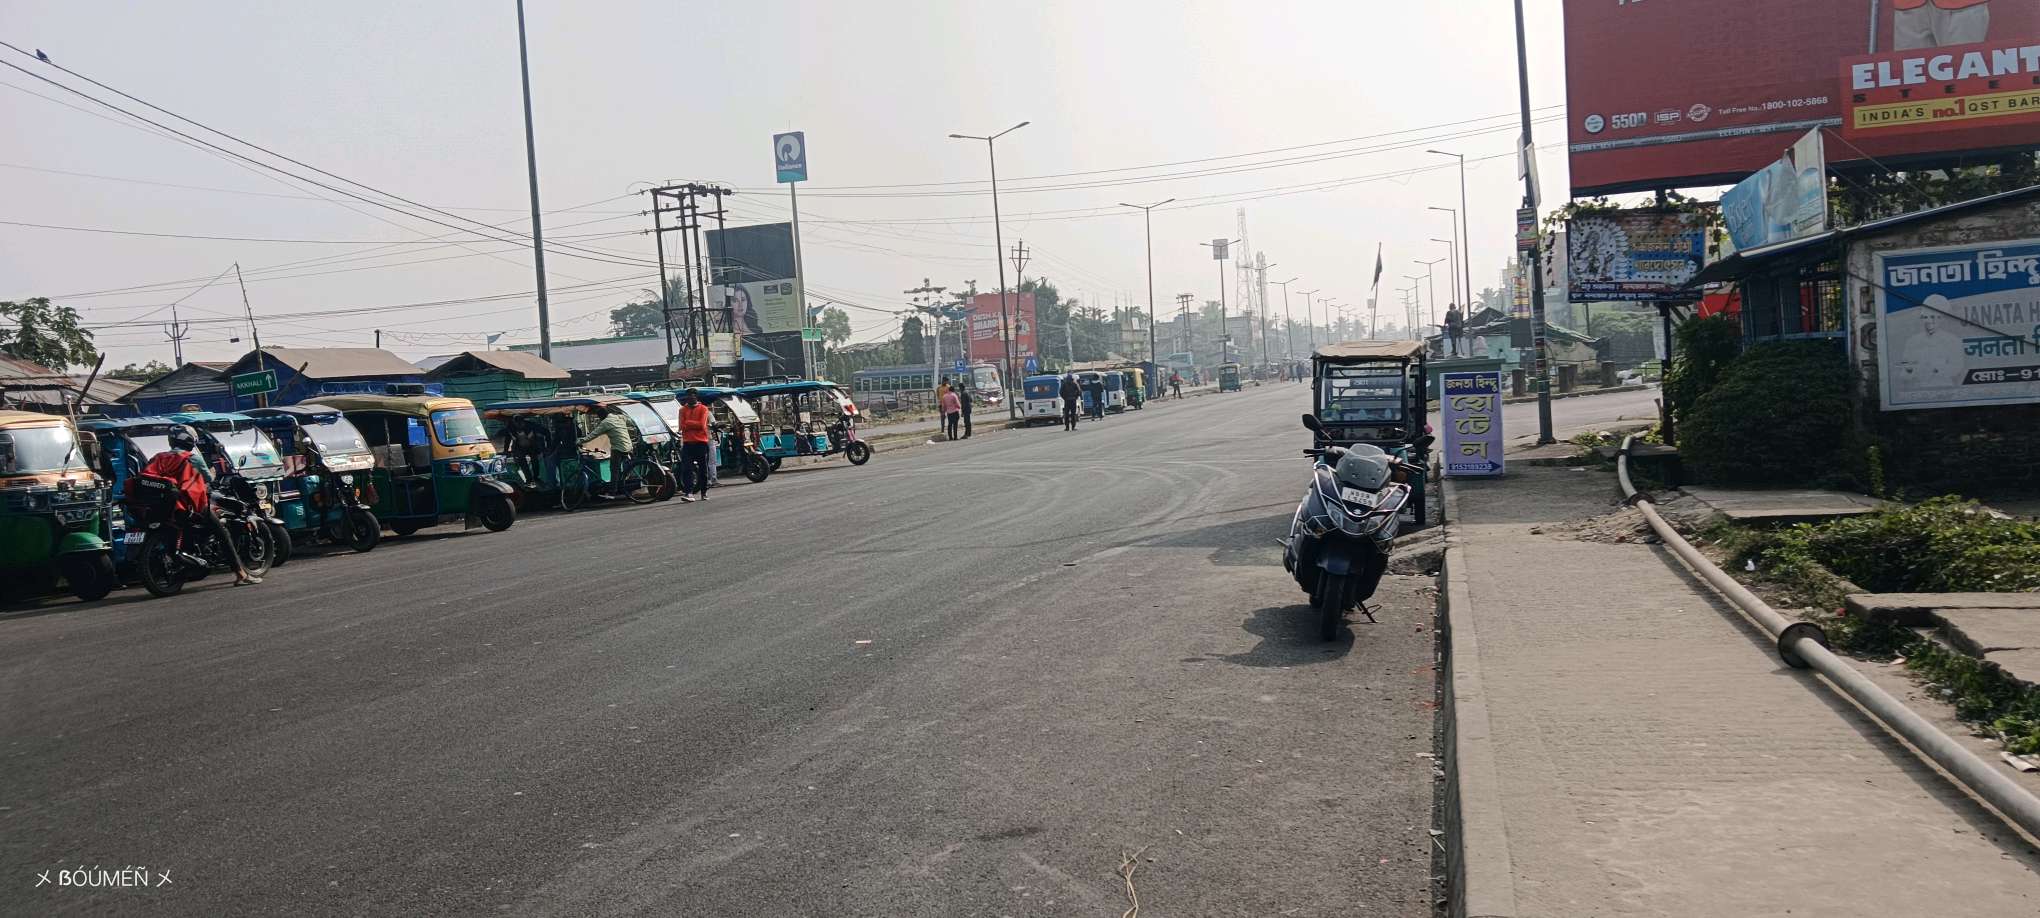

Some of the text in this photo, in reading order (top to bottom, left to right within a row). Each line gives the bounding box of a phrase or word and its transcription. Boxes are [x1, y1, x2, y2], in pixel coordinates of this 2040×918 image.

[1852, 45, 2040, 90] ELEGANT
[1862, 107, 1926, 122] INDIA'S
[1968, 100, 2001, 112] QST
[1887, 259, 1973, 287] জনতা
[1961, 302, 2024, 327] JANATA
[1962, 334, 2026, 358] जनता
[1446, 378, 1473, 390] জনতা
